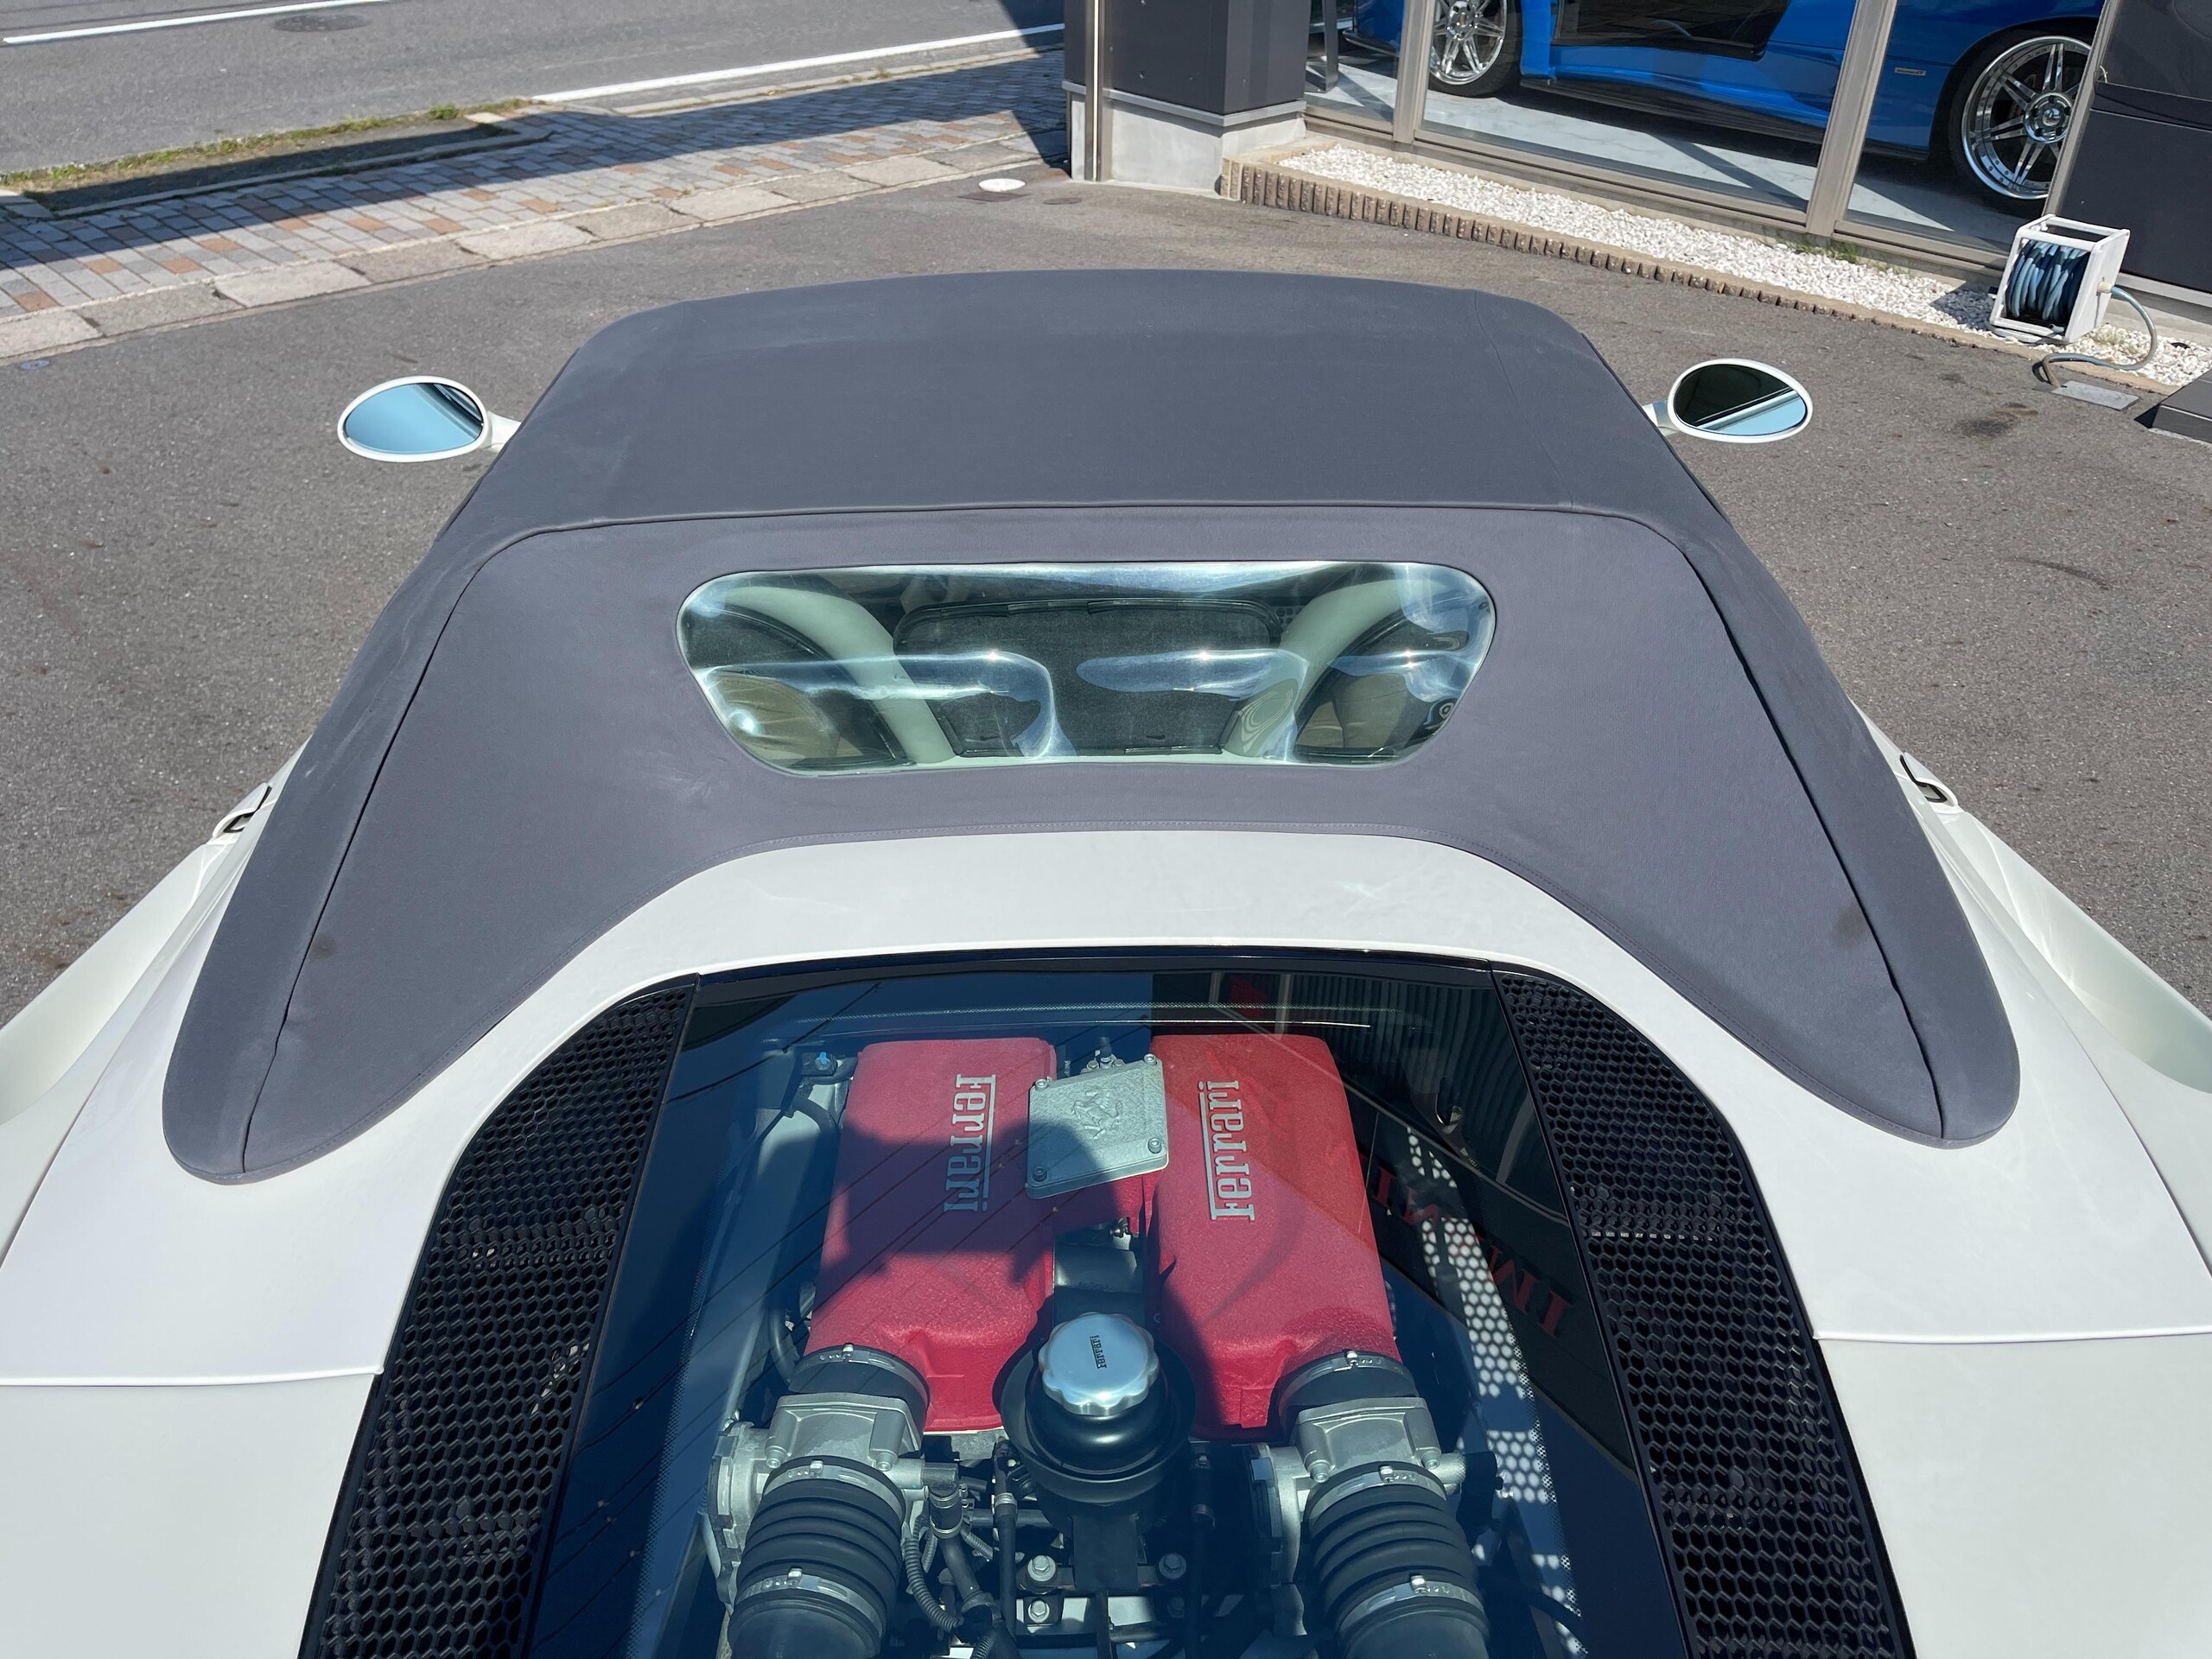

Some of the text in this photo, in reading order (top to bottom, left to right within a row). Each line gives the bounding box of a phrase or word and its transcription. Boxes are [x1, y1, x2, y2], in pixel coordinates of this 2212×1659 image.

[944, 1074, 995, 1211] Ferrari
[1198, 1080, 1255, 1220] Ferrari
[1090, 1335, 1107, 1369] Ferrari
